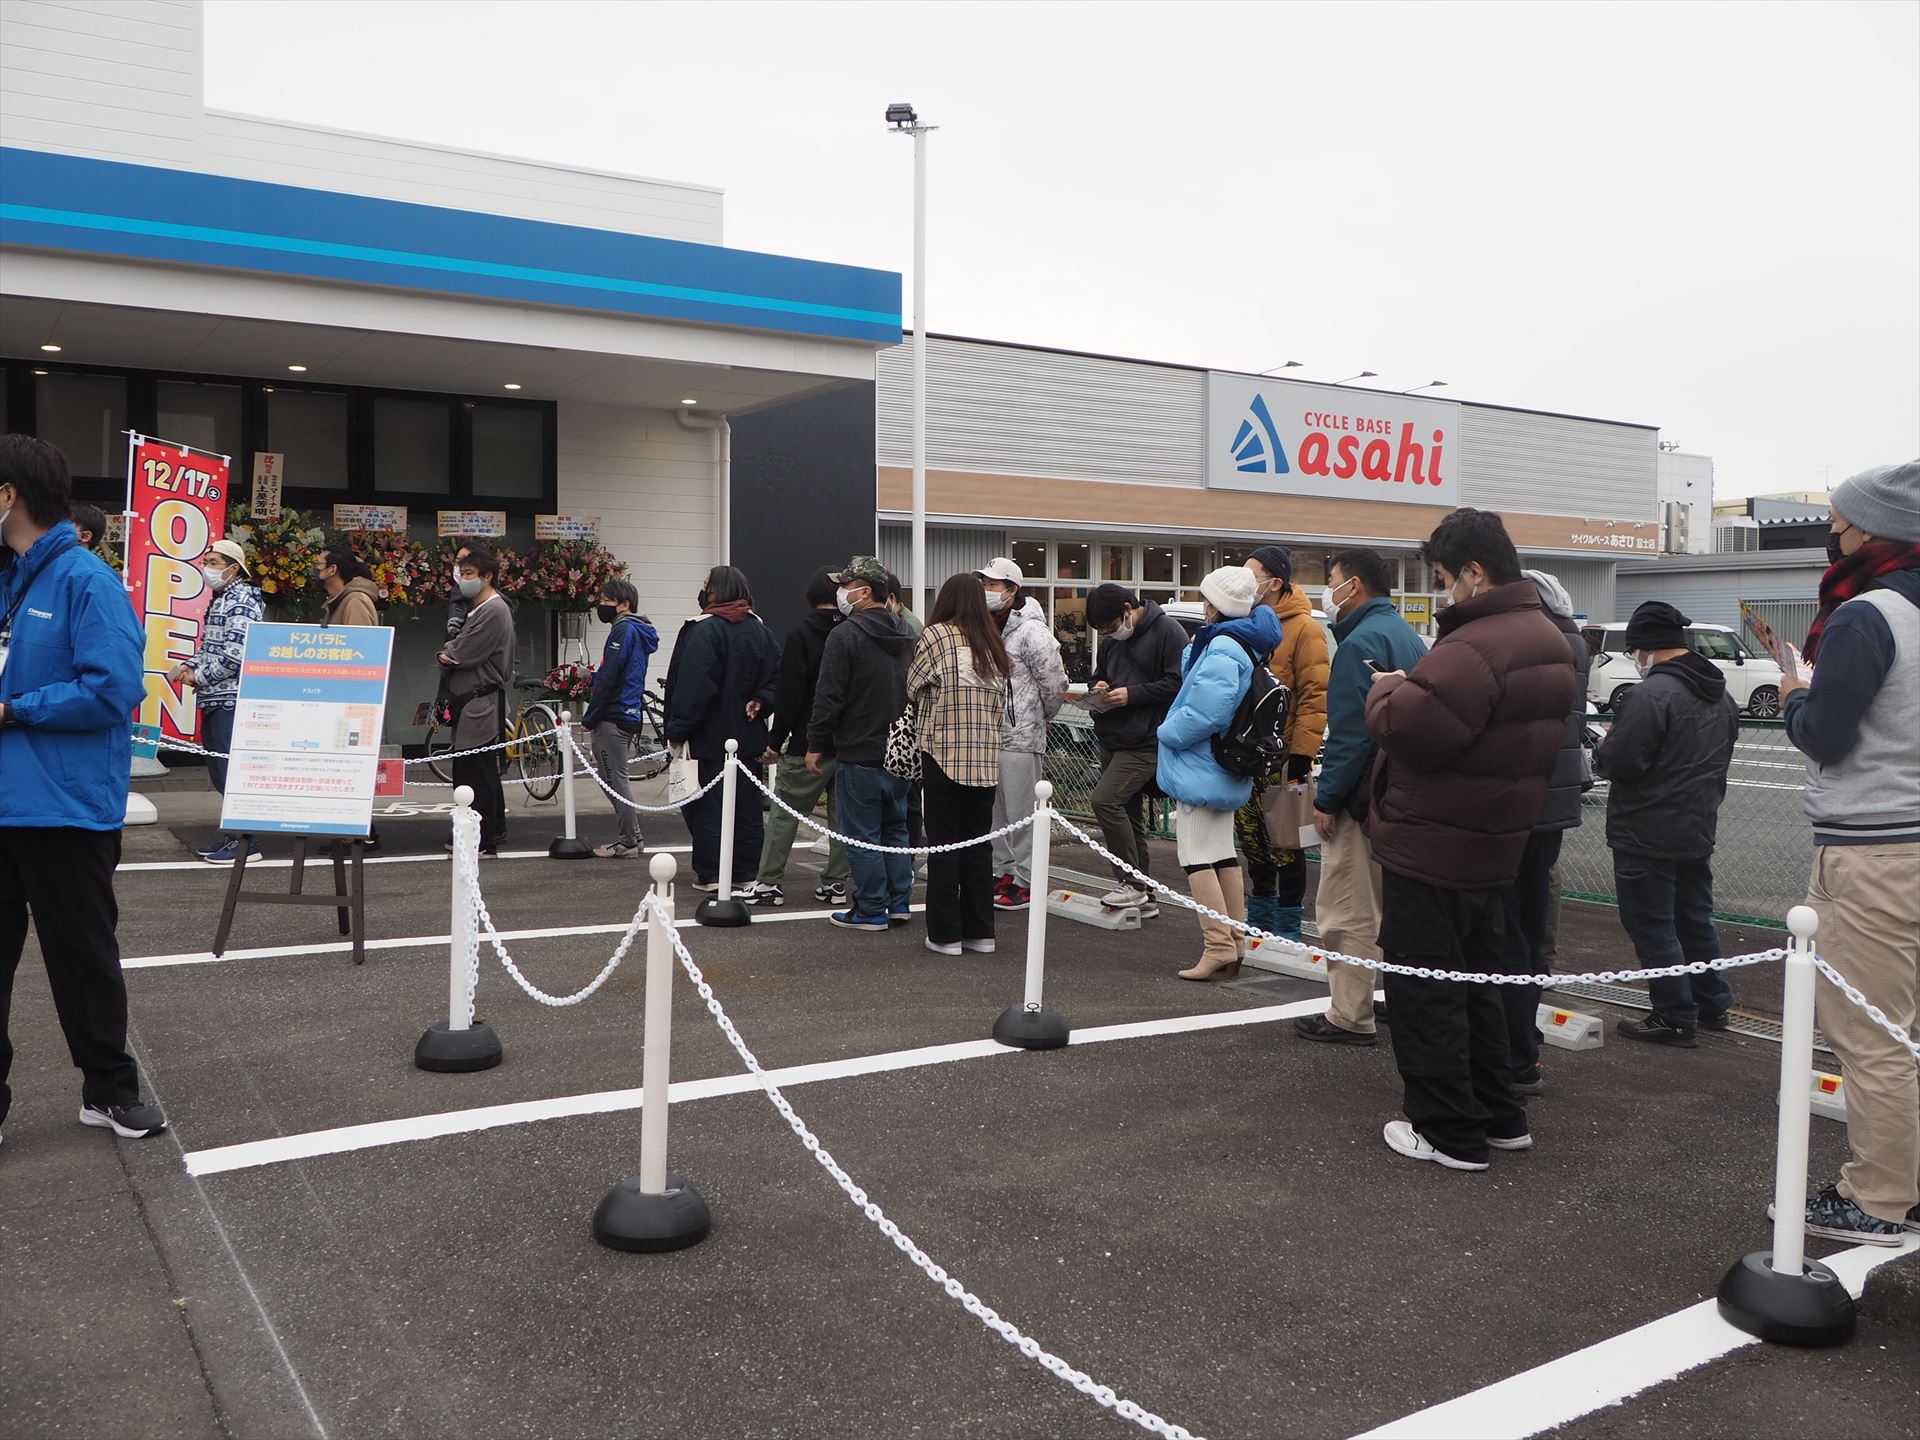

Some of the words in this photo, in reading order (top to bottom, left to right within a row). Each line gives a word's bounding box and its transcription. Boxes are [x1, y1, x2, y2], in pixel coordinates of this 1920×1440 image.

[1304, 411, 1349, 430] CYCLE
[1356, 417, 1392, 435] BASE
[1298, 422, 1443, 486] asahi
[142, 458, 211, 498] 12/17
[139, 499, 211, 735] OPEN
[268, 646, 365, 661] お越しのお客様へ
